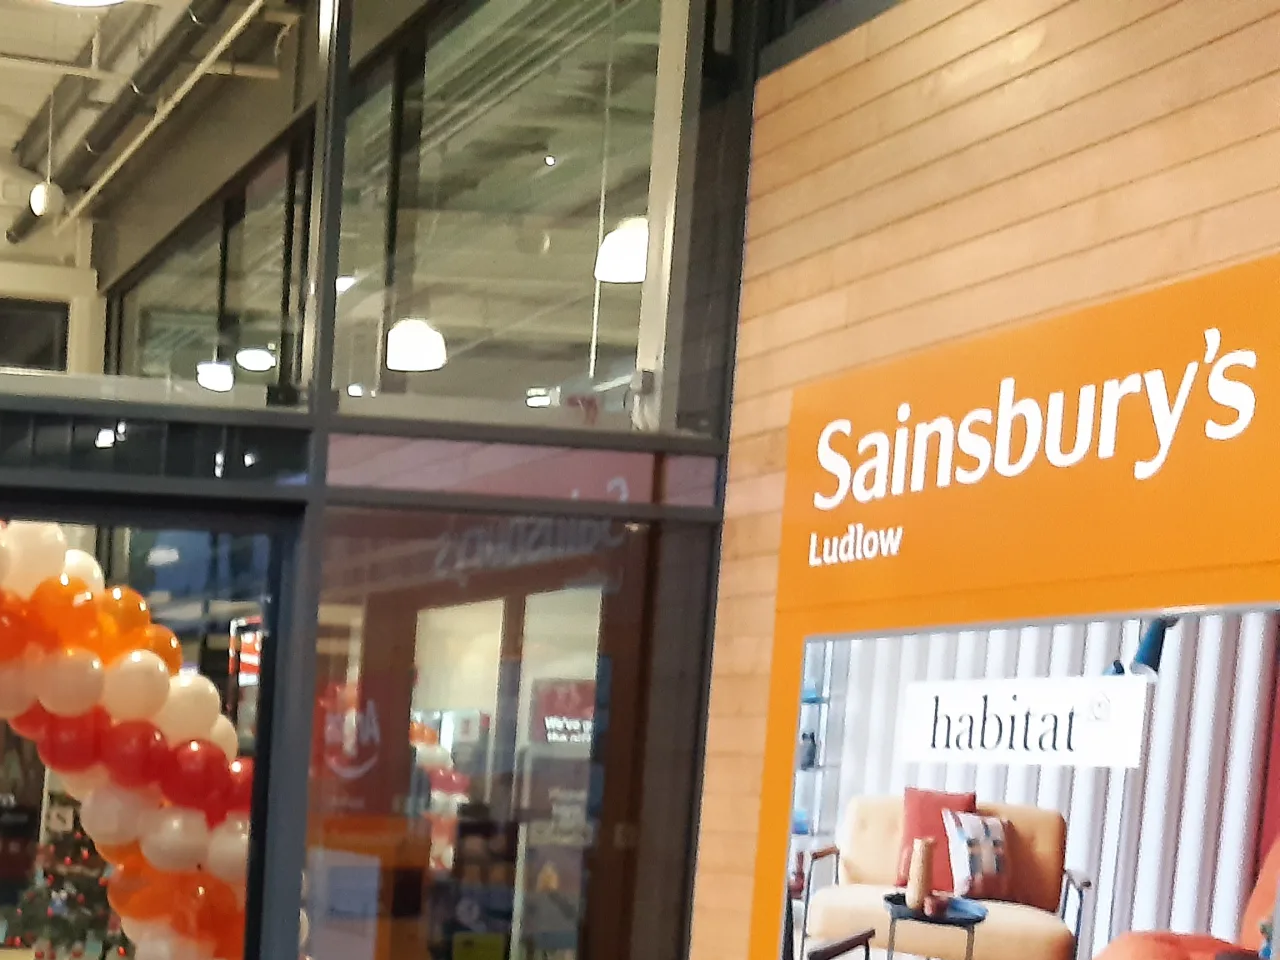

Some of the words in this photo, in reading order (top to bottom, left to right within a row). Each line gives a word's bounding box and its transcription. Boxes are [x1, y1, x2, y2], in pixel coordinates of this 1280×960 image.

[813, 327, 1257, 511] Sainsbury's
[808, 524, 904, 568] Ludlow
[930, 693, 1084, 752] habitat
